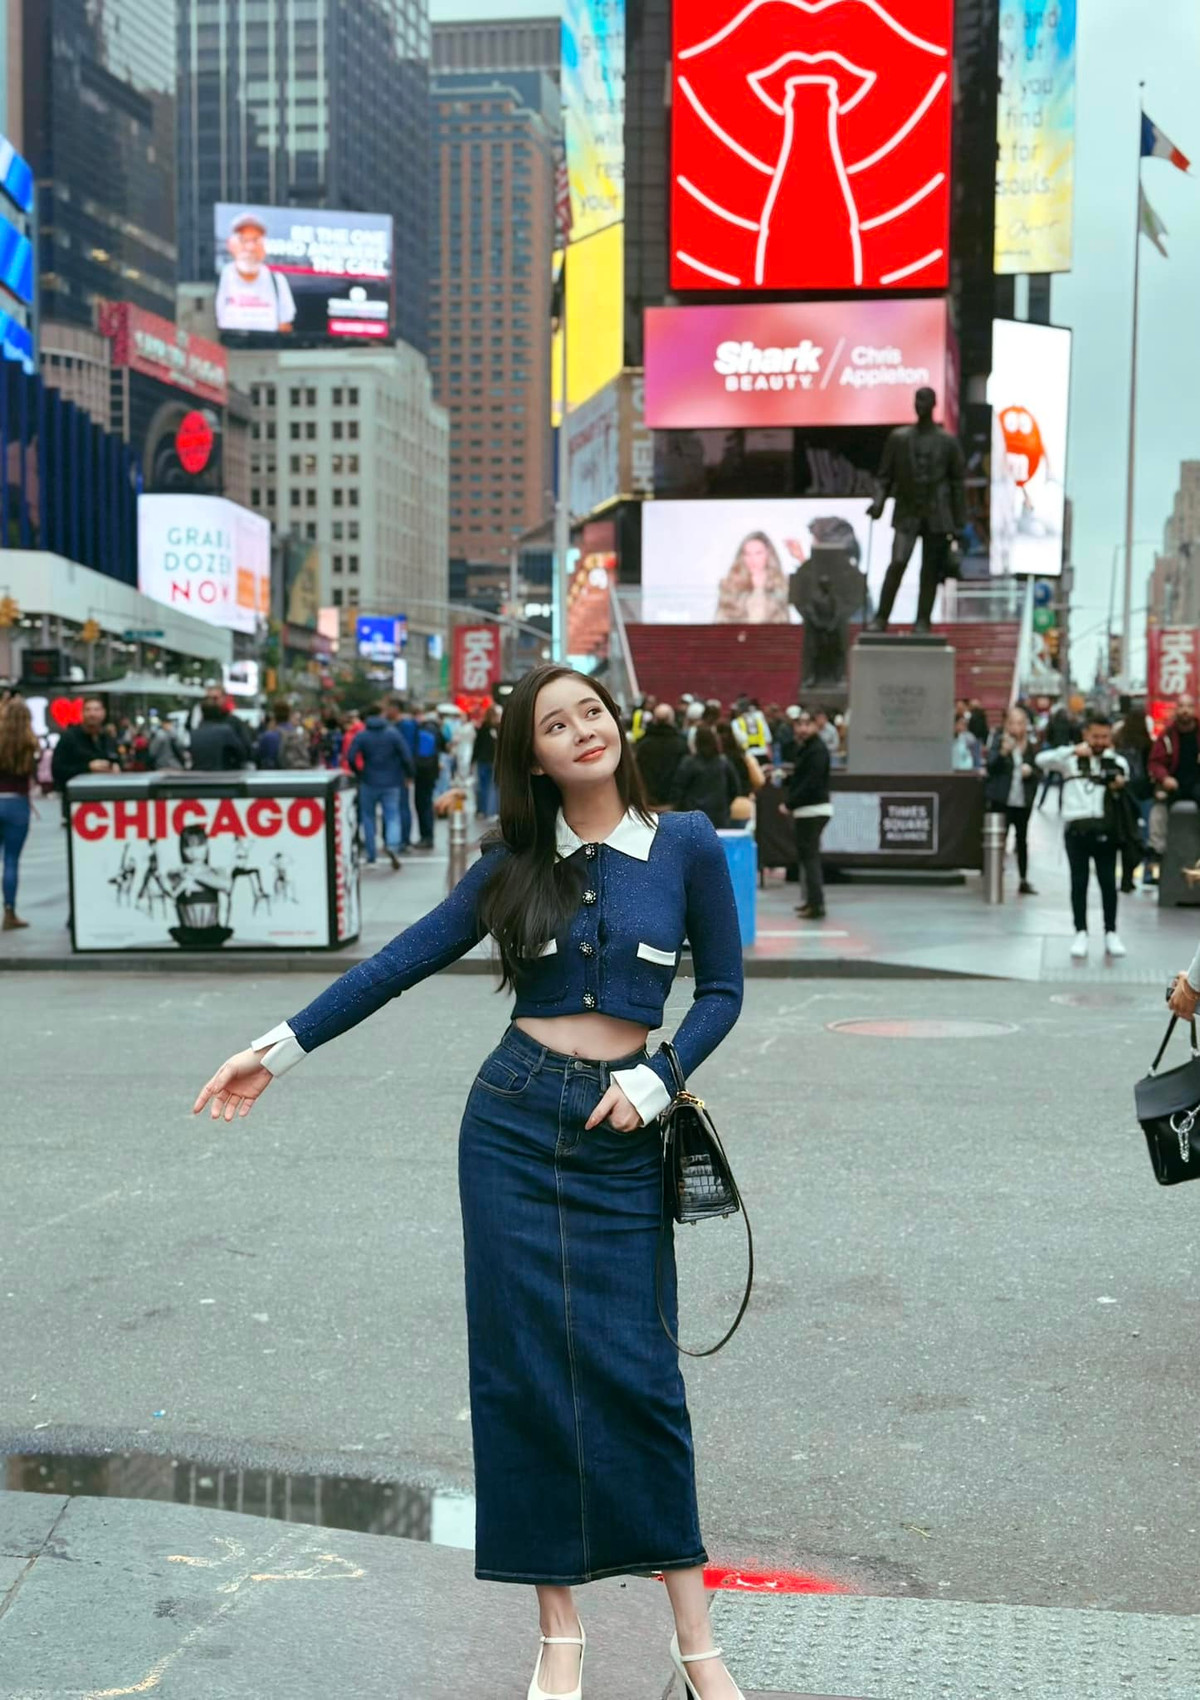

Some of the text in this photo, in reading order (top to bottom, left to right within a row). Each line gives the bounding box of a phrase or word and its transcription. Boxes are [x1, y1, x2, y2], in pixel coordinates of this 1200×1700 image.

[1021, 78, 1053, 100] you
[714, 339, 823, 374] Shark
[851, 345, 902, 365] Chris
[840, 366, 930, 388] Appleton
[464, 629, 494, 690] tkts
[1161, 633, 1194, 695] tkts
[72, 798, 325, 841] CHICAGO
[888, 804, 927, 818] TIMES
[883, 818, 930, 831] SQUARE
